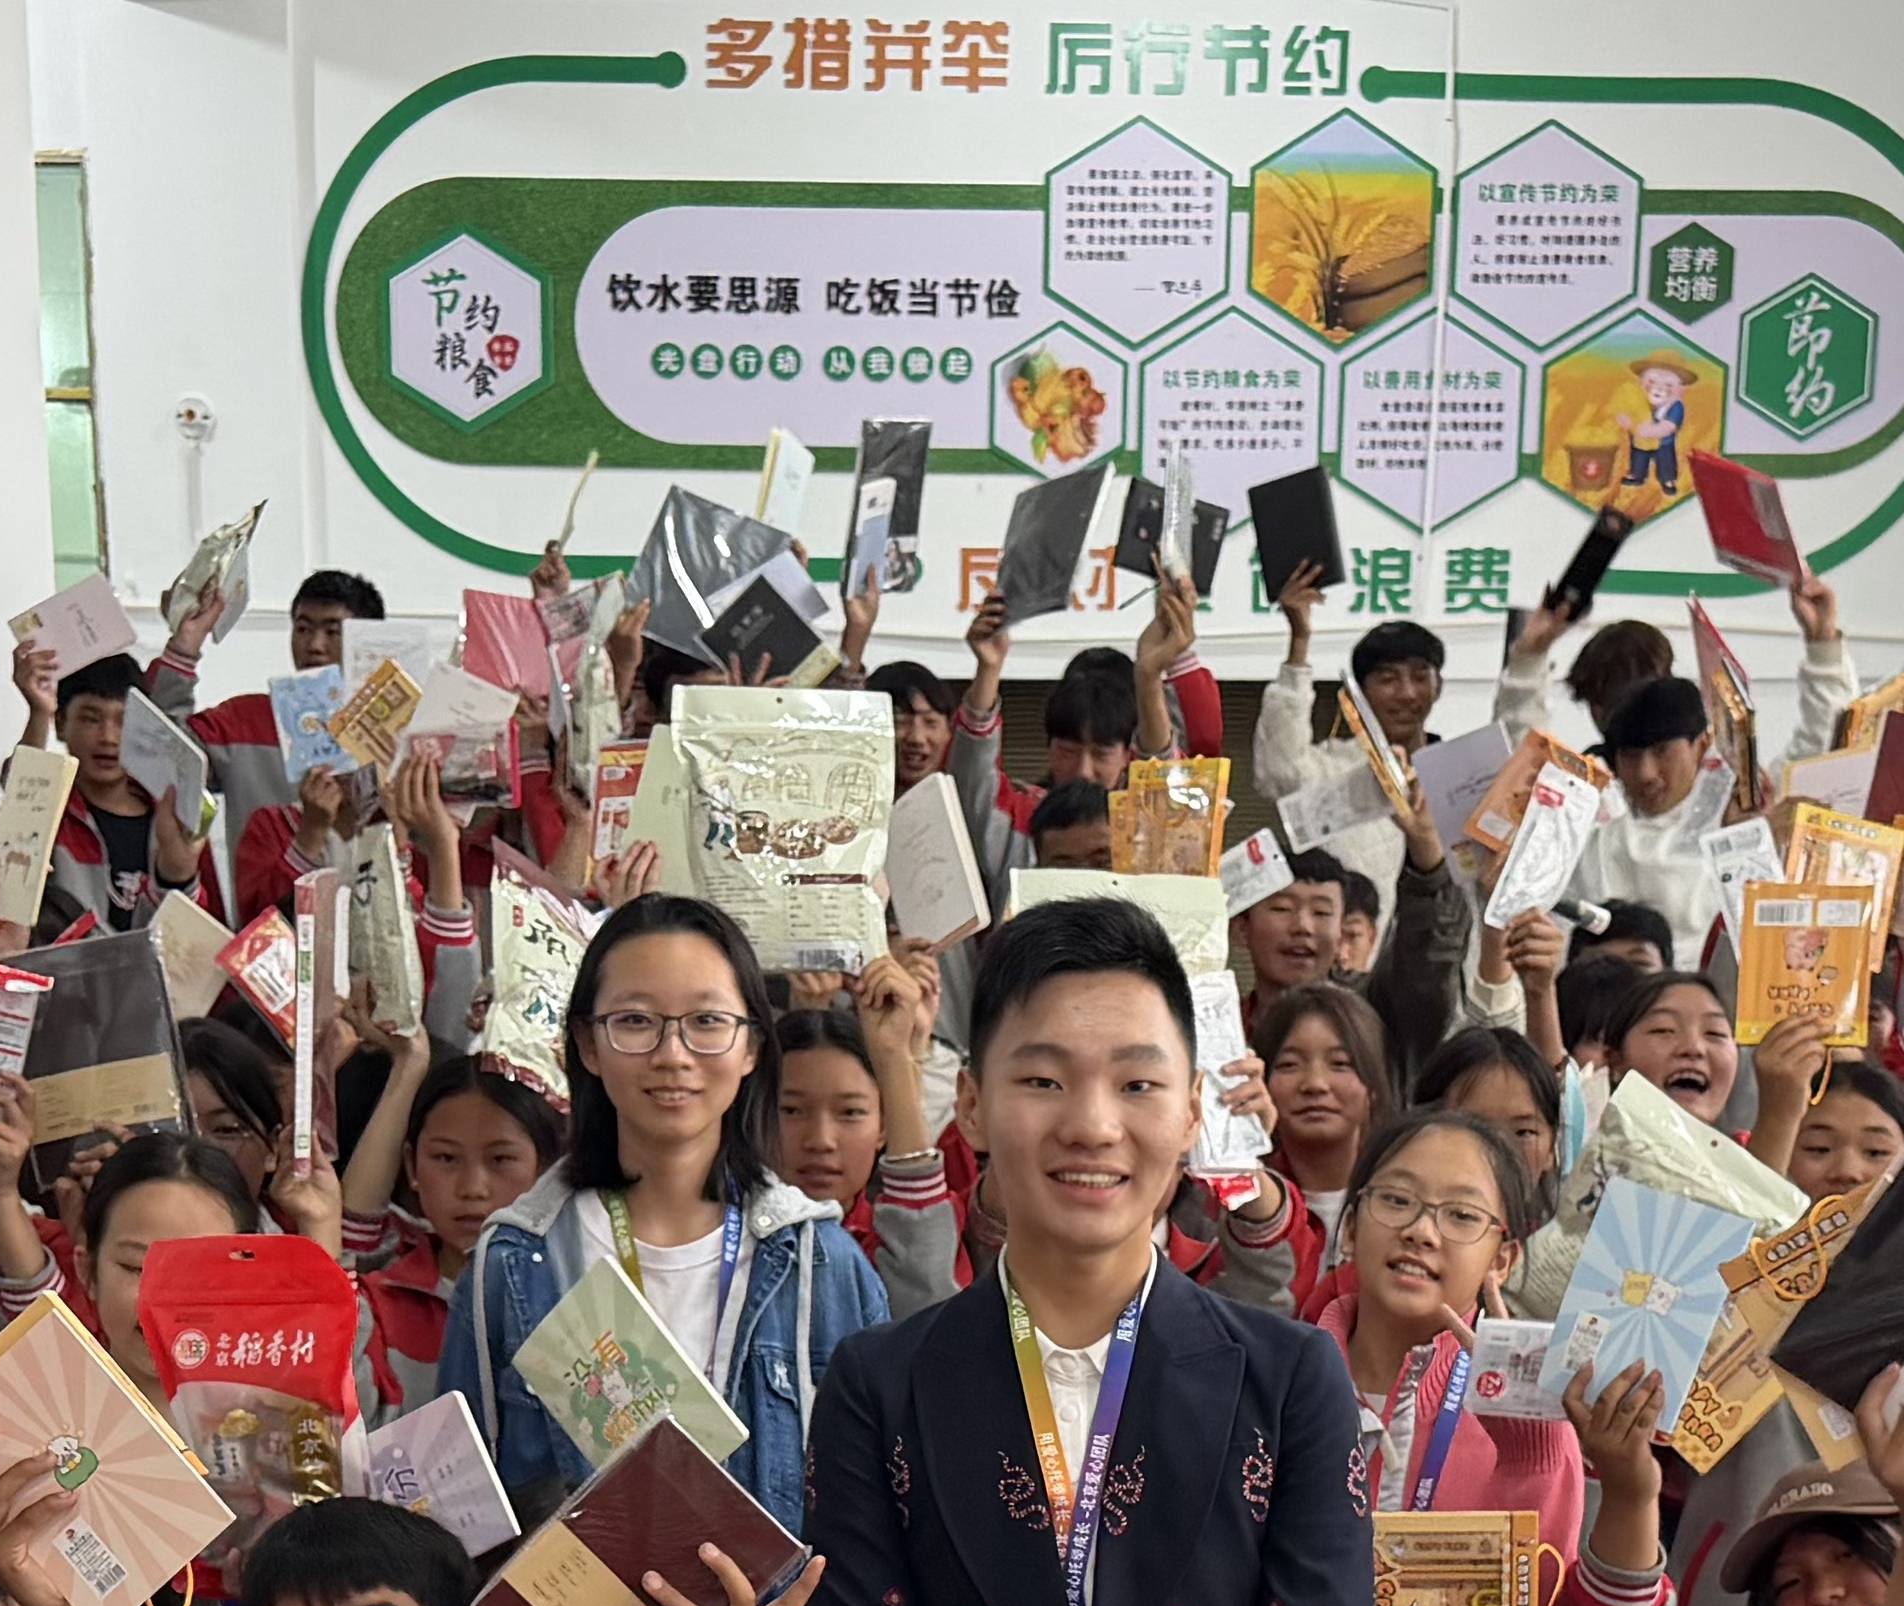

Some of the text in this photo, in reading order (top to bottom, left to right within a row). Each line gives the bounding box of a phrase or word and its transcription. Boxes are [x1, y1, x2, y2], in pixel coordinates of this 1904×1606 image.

[706, 19, 1350, 98] 多措并举 厉行节约
[1479, 183, 1619, 203] 以宣传节约为荣
[1666, 246, 1718, 273] 营养
[421, 268, 500, 334] 节约
[607, 274, 1020, 320] 饮水要思源 吃饭当节俭
[433, 332, 498, 399] 粮食
[654, 344, 972, 381] 光盘行动 从我做起
[1162, 369, 1302, 390] 以节约粮食为荣
[231, 1328, 317, 1368] 稻香村
